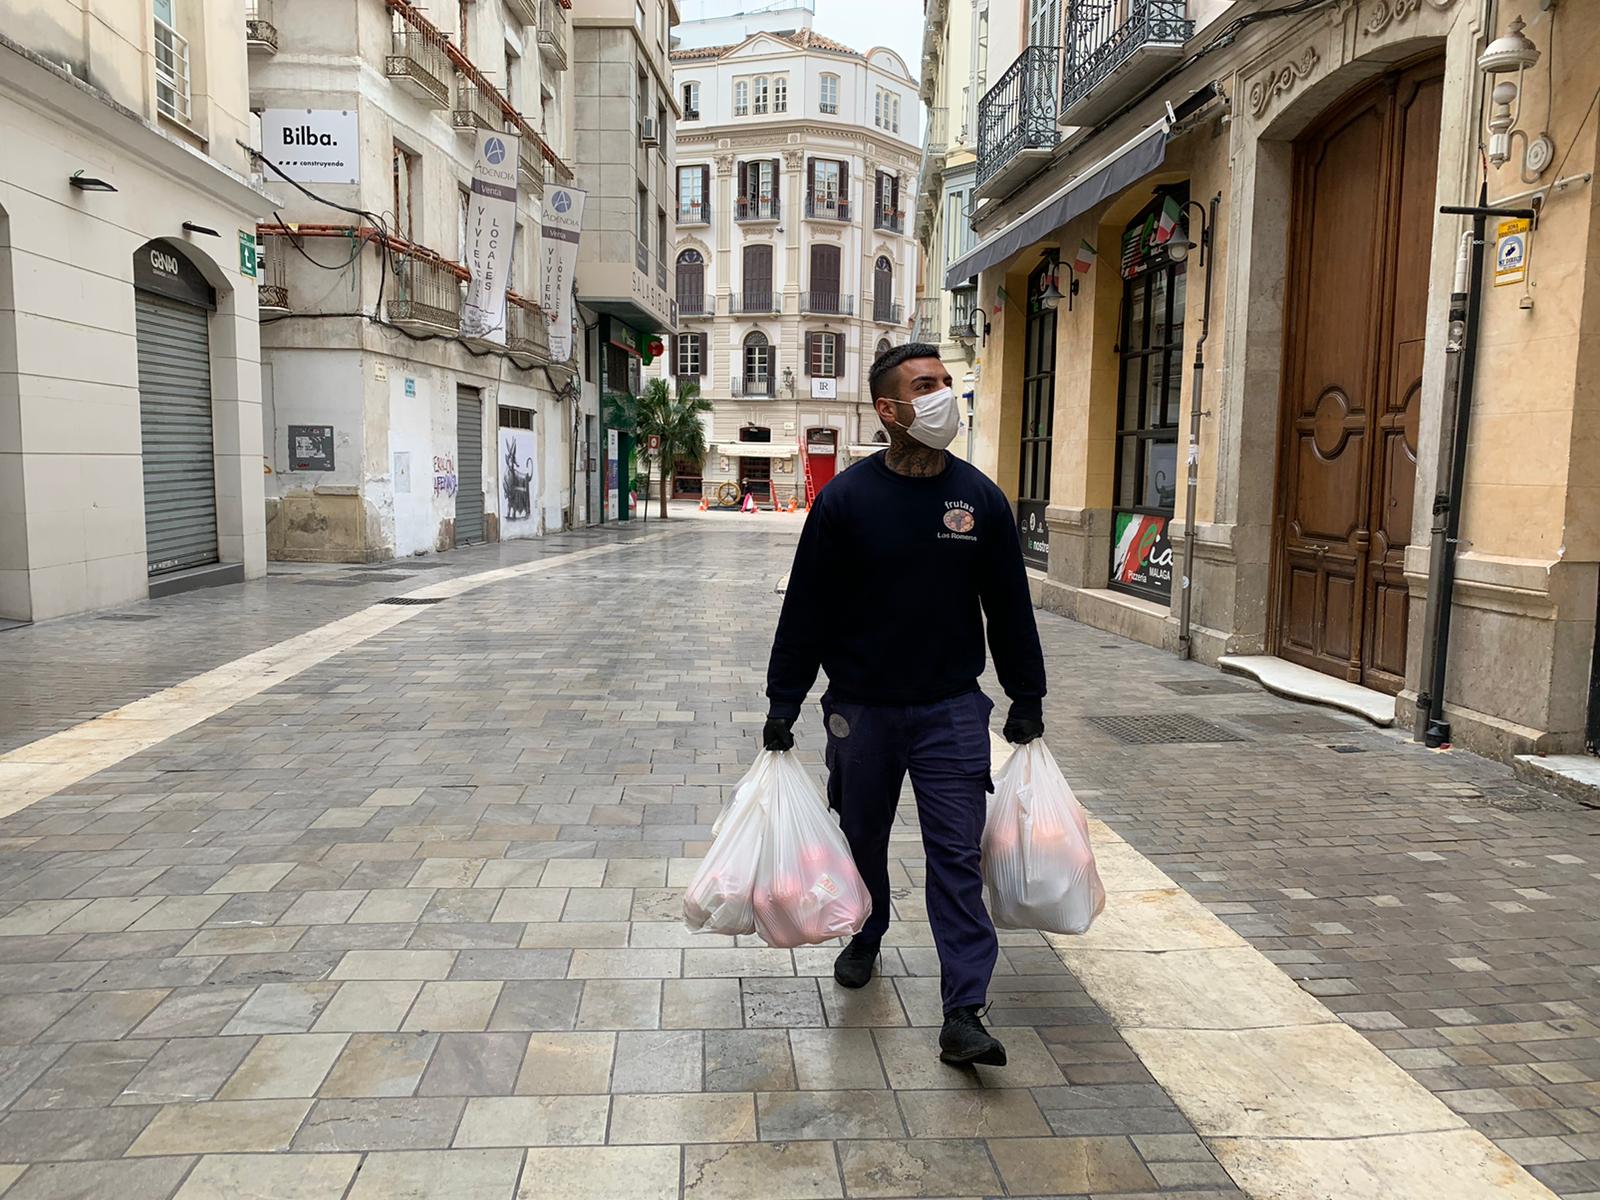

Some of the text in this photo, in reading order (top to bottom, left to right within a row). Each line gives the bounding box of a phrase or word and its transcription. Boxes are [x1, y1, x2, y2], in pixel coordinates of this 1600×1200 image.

[282, 125, 338, 146] Bilba.
[480, 184, 503, 197] Venta
[484, 218, 500, 291] LOCALES
[944, 500, 974, 513] frutas
